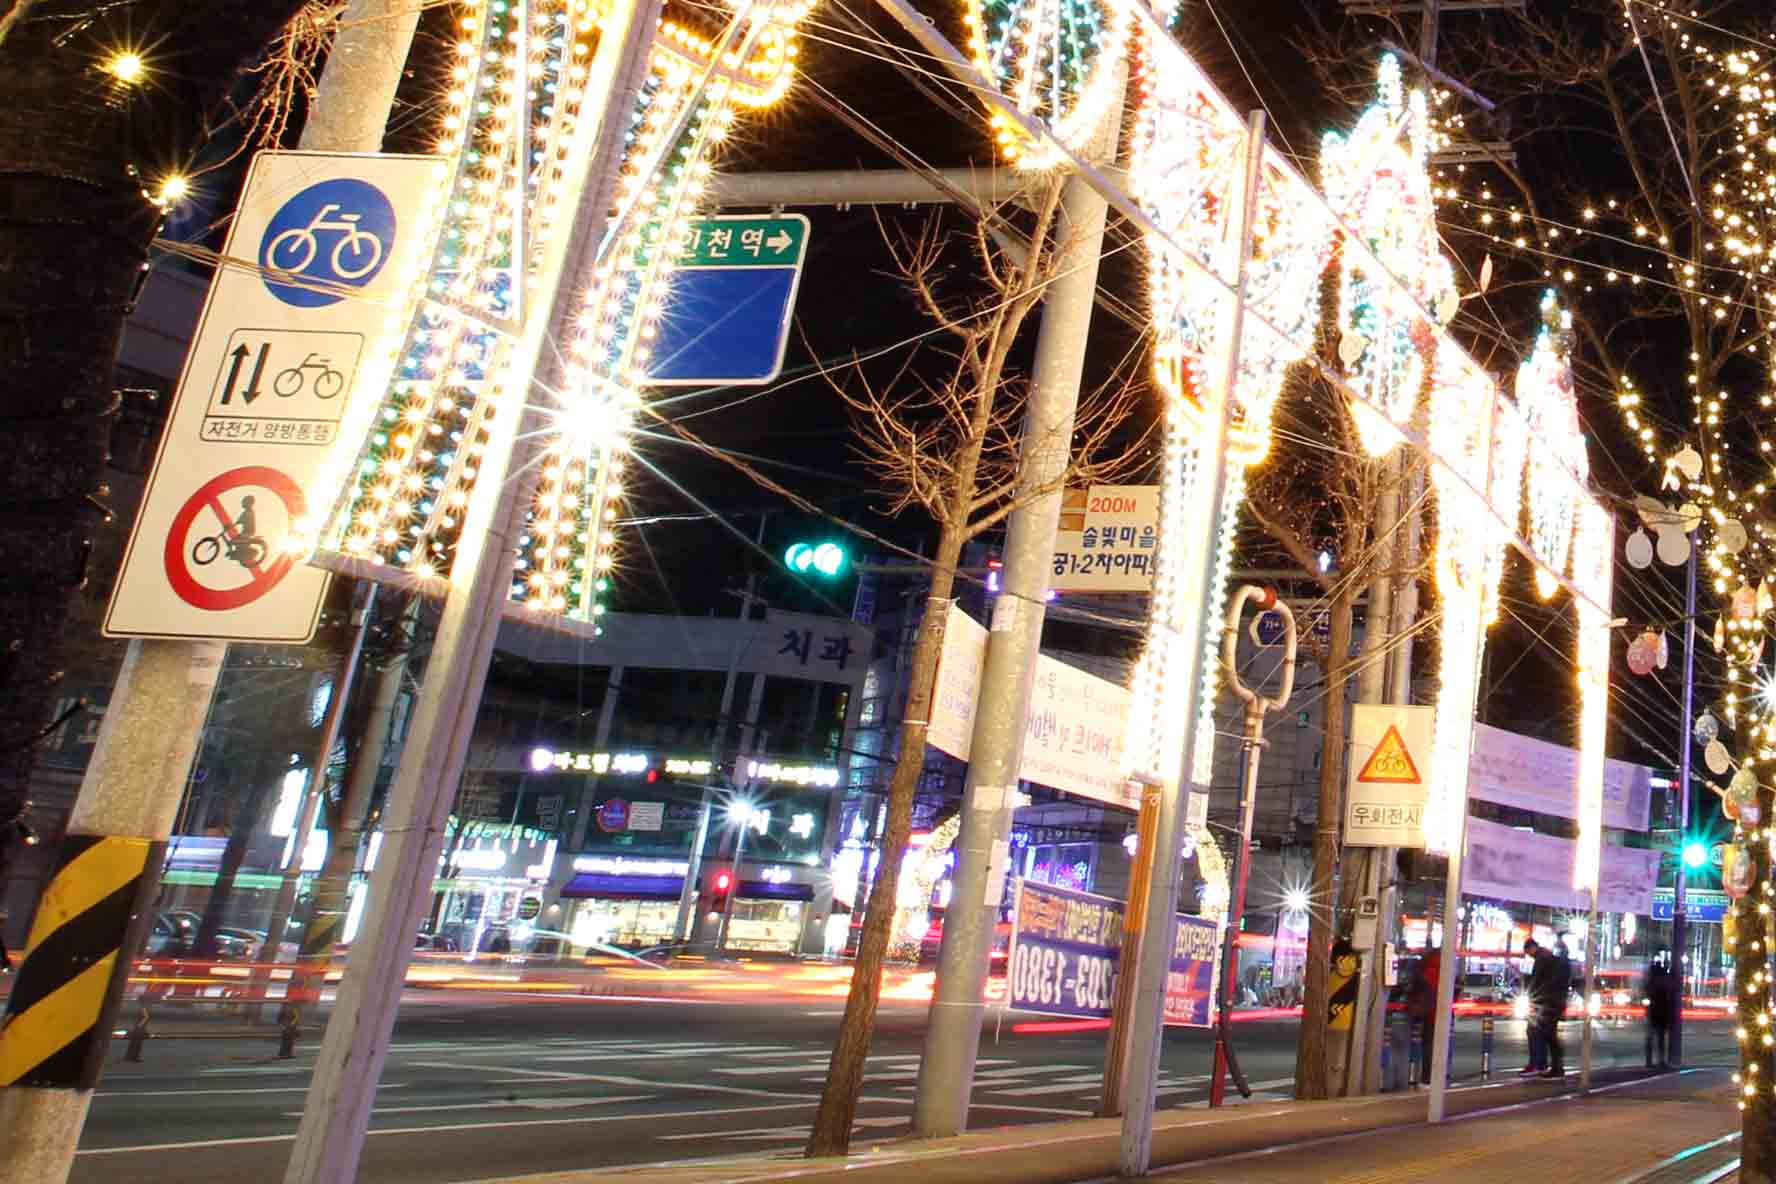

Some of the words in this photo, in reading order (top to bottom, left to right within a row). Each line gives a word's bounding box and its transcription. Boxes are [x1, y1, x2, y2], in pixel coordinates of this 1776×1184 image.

[644, 227, 764, 258] 인천역
[207, 420, 258, 439] 자전거
[263, 422, 329, 441] 양방통행
[1089, 497, 1137, 513] 200M
[1082, 525, 1156, 549] 솔빛마을
[778, 628, 852, 670] 치과
